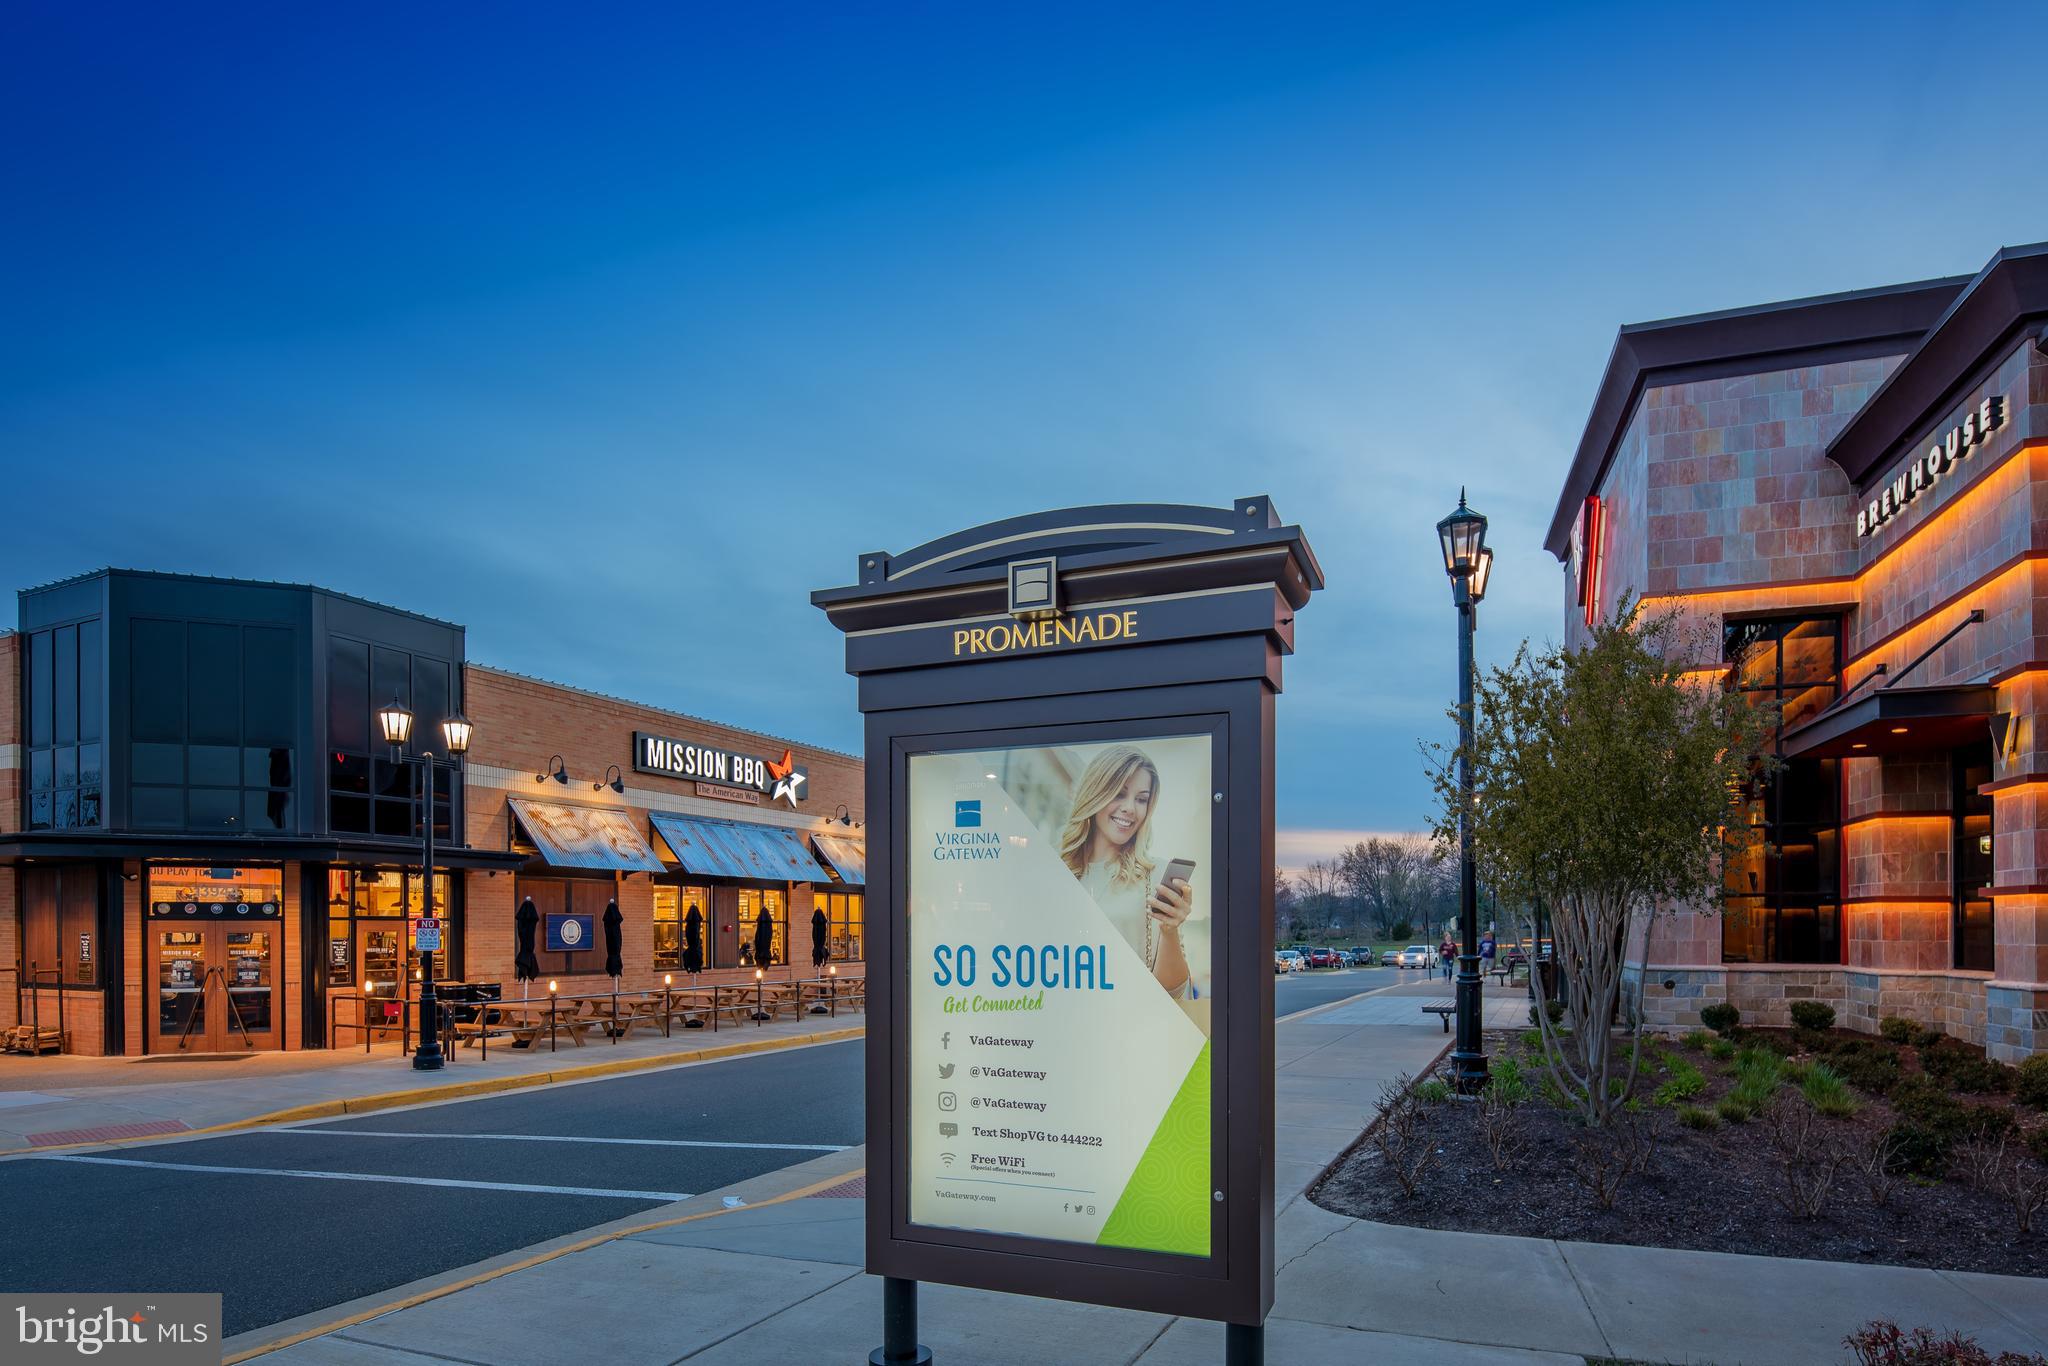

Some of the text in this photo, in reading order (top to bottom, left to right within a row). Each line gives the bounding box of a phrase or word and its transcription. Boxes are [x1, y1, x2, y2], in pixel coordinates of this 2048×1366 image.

[1857, 396, 2001, 537] BREWHOUSE
[953, 610, 1138, 656] PROMENADE
[646, 737, 765, 790] MISSION BBQ
[697, 783, 759, 803] The American Way
[935, 832, 1000, 845] VIRGINIA
[933, 846, 1002, 861] GATEWAY
[166, 867, 189, 876] PLAY
[421, 920, 435, 928] NO
[933, 944, 1115, 990] SO SOCIAL
[943, 990, 1045, 1015] Get Connected
[969, 1035, 1035, 1049] VaGateway
[981, 1067, 1047, 1081] VaGateway
[982, 1098, 1047, 1113] VaGateway
[972, 1126, 1103, 1147] Text ShopVG to 444222
[970, 1153, 1026, 1168] Free WiFi
[935, 1190, 997, 1203] VaGateway.com
